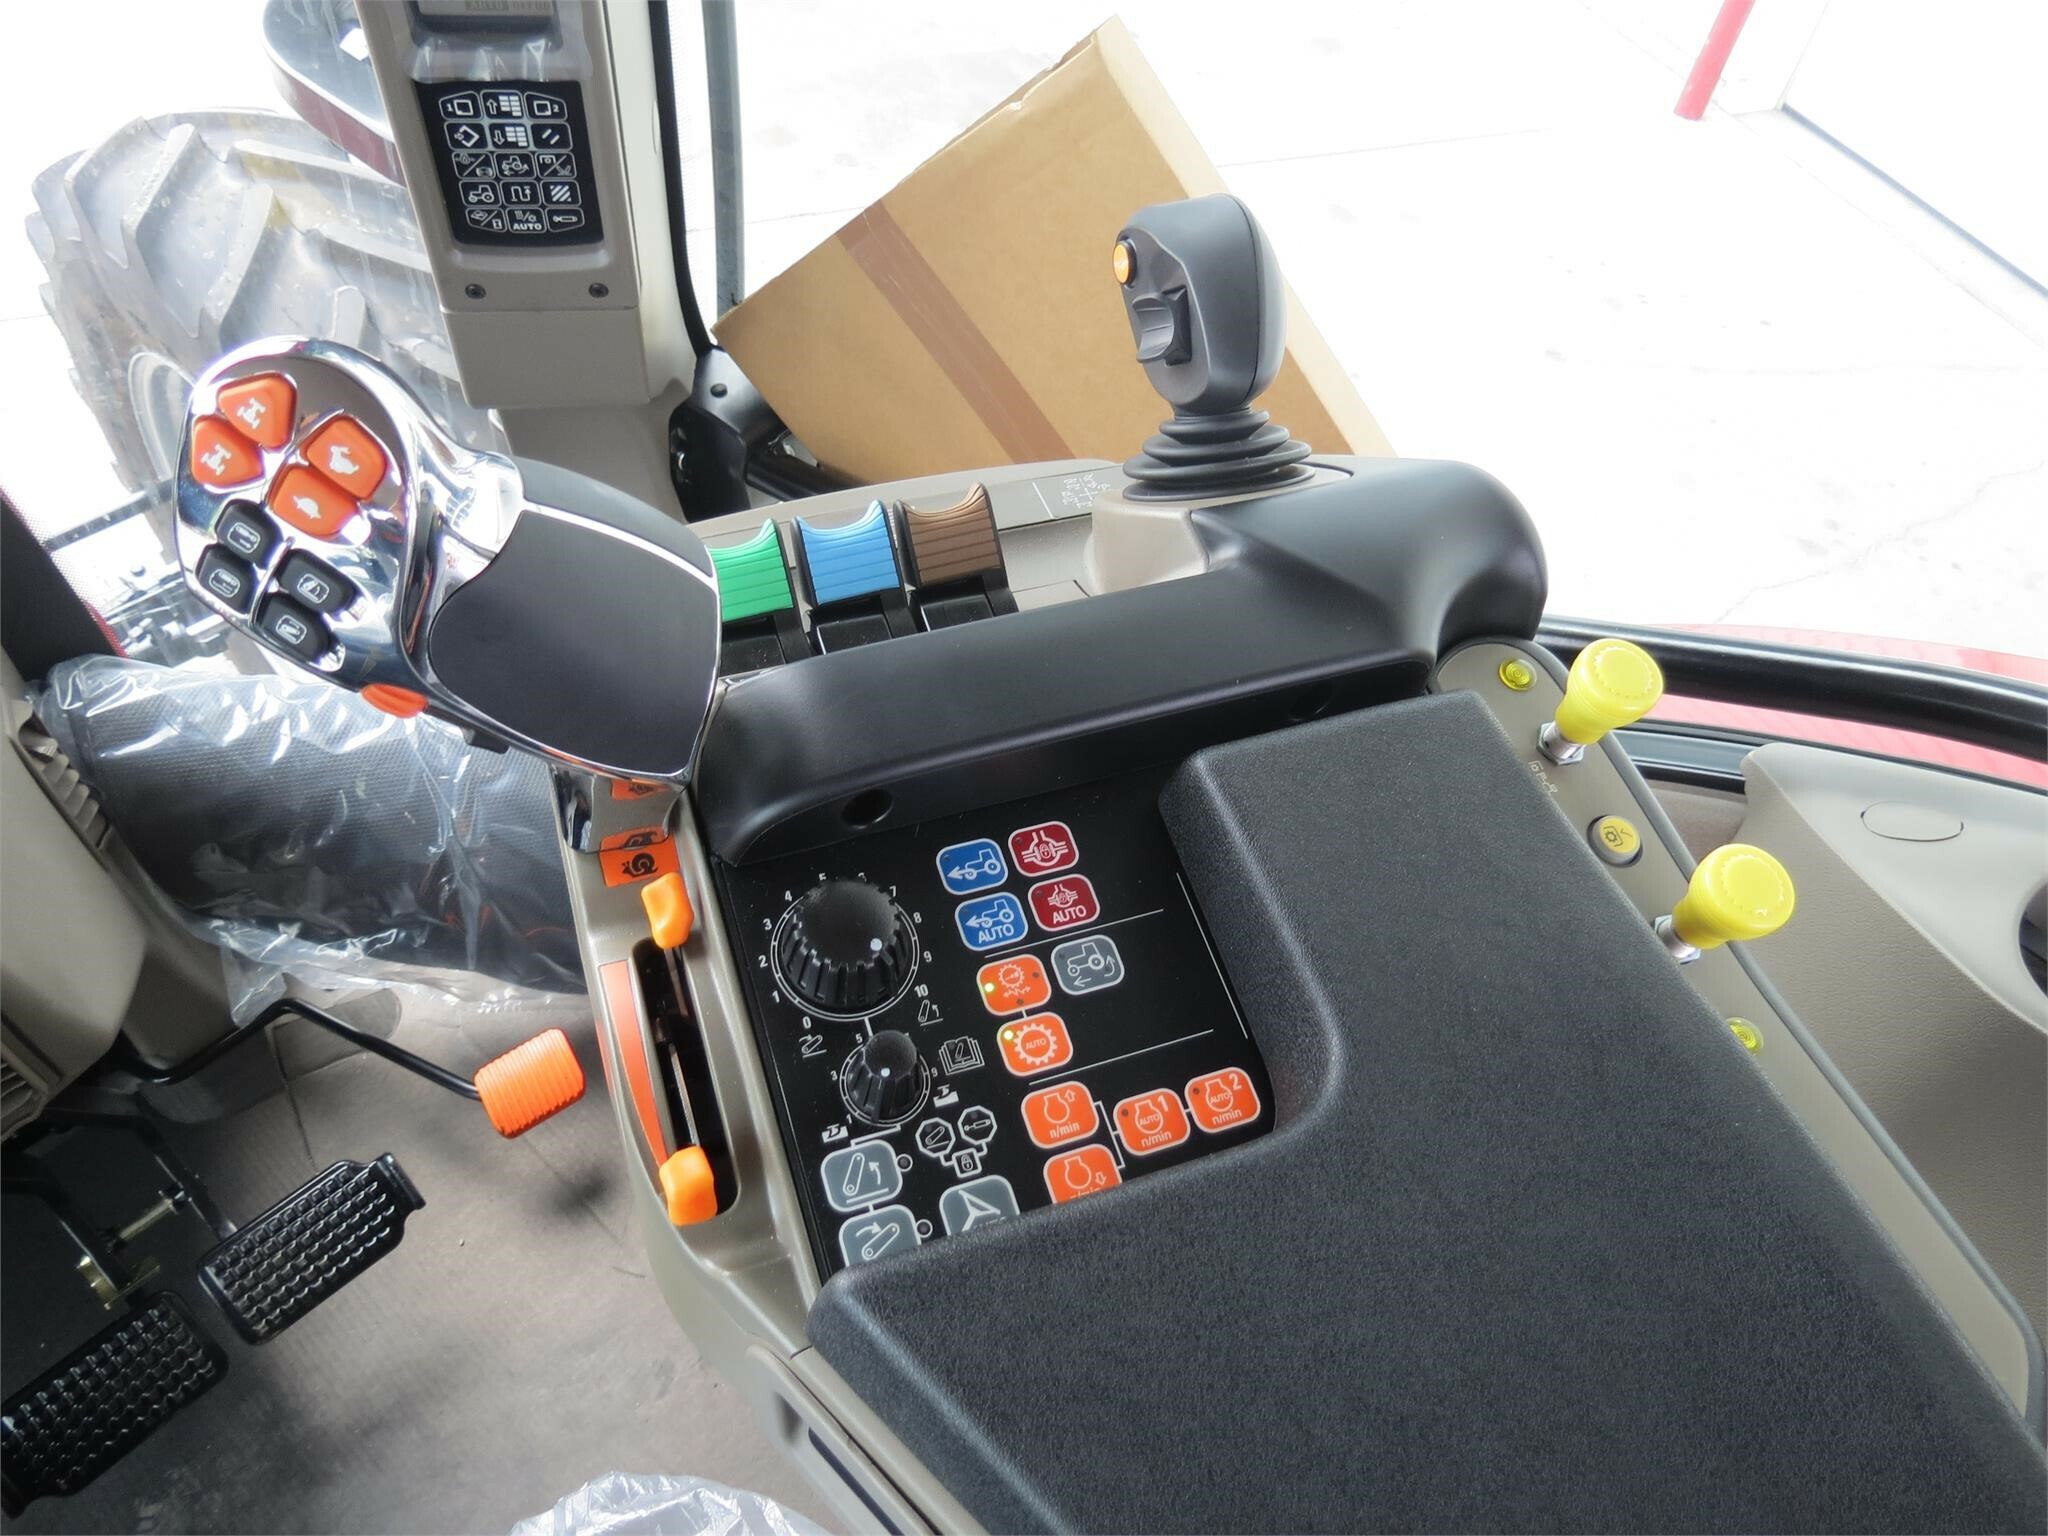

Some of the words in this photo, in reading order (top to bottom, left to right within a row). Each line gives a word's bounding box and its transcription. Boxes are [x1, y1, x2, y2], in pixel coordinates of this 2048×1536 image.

[513, 223, 542, 231] AUTO
[785, 890, 793, 902] 4
[890, 886, 897, 897] 7
[913, 912, 922, 924] 8
[1052, 904, 1087, 925] AUTO
[763, 918, 773, 931] 3
[978, 923, 1015, 944] AUTO
[758, 955, 769, 969] 2
[924, 951, 933, 963] 9
[772, 991, 780, 1004] 1
[914, 984, 929, 998] 10
[803, 1016, 812, 1029] 0
[855, 1033, 863, 1044] 5
[1025, 1038, 1047, 1050] AUTO
[830, 1071, 839, 1081] 3
[931, 1067, 939, 1077] 9
[1229, 1073, 1242, 1091] 2
[1157, 1096, 1169, 1113] 1
[1210, 1093, 1230, 1105] AUTO
[846, 1114, 853, 1124] 1
[1139, 1113, 1160, 1127] AUTO
[1212, 1109, 1243, 1126] n/min
[1049, 1122, 1081, 1139] n/min
[1140, 1130, 1172, 1148] n/min
